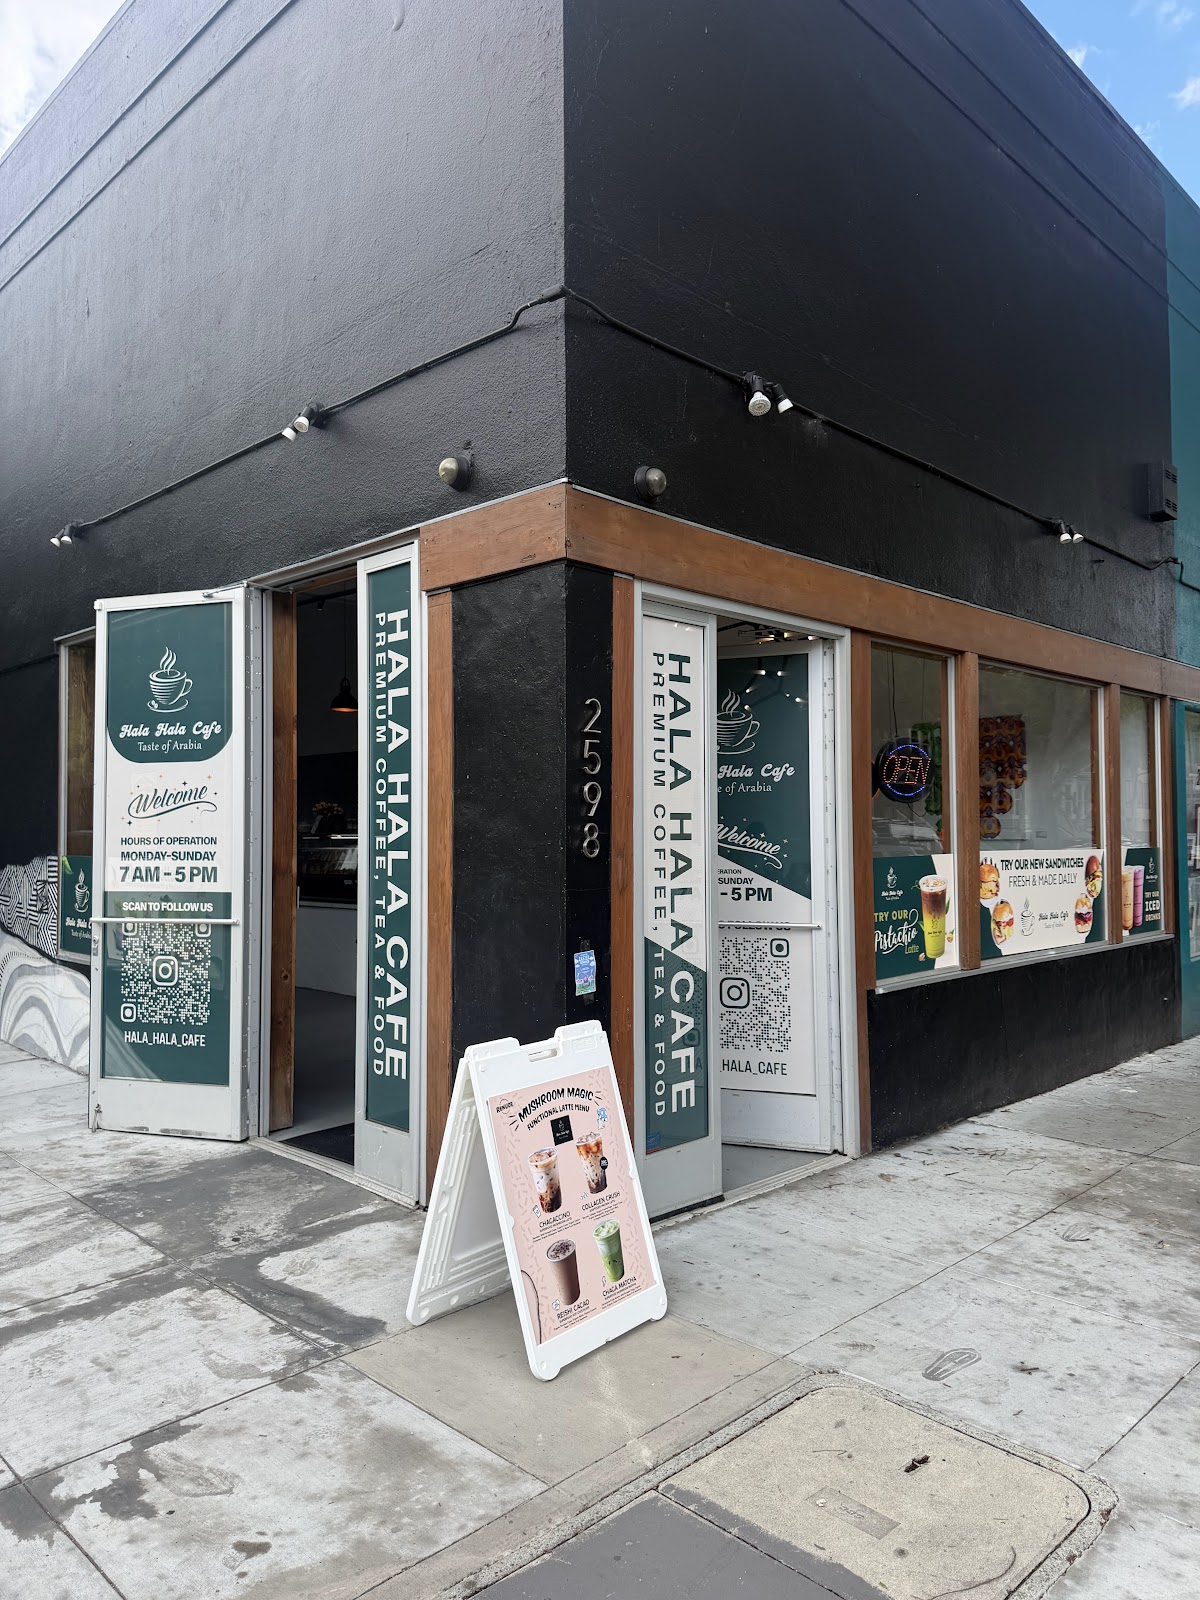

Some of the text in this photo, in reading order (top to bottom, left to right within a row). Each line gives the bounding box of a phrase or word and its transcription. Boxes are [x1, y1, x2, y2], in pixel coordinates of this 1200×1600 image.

[119, 721, 222, 740] Hala Hala Cafe
[138, 739, 202, 754] Taste of Arabia
[582, 698, 602, 858] 2598
[717, 763, 796, 782] Hala Cafe
[883, 755, 932, 785] OPEN
[725, 781, 737, 796] of
[737, 781, 772, 792] Arabia
[130, 785, 211, 818] Welcome
[121, 836, 217, 845] HOURS OF OPERATION
[373, 612, 387, 1075] PREMIUM COFFEE, TEA & FOOD
[385, 609, 409, 1080] HALA HALA CAFE
[717, 823, 781, 859] Welcome
[121, 851, 216, 861] MONDAY-SUNDAY
[1000, 857, 1084, 870] TRY OUR NEW SANDWICHES
[652, 652, 667, 1116] PREMIUM COFFEE, TEA & FOOD
[668, 653, 696, 1112] HALA HALA CAFE
[1008, 873, 1078, 887] FRESH & MADE DAILY
[122, 902, 214, 912] SCAN TO FOLLOW US
[1145, 900, 1160, 911] ICED
[874, 909, 908, 922] TRY OUR
[874, 917, 918, 952] Pistachio
[124, 1031, 206, 1047] HALA_HALA_CAFE
[721, 1059, 788, 1075] HALA_CAFE
[518, 1087, 594, 1122] MUSHROOM MAGIC
[527, 1103, 590, 1130] FUNCTIONAL LATTE MENU
[581, 1197, 605, 1211] COLLAGEN
[605, 1191, 620, 1201] CRUSH
